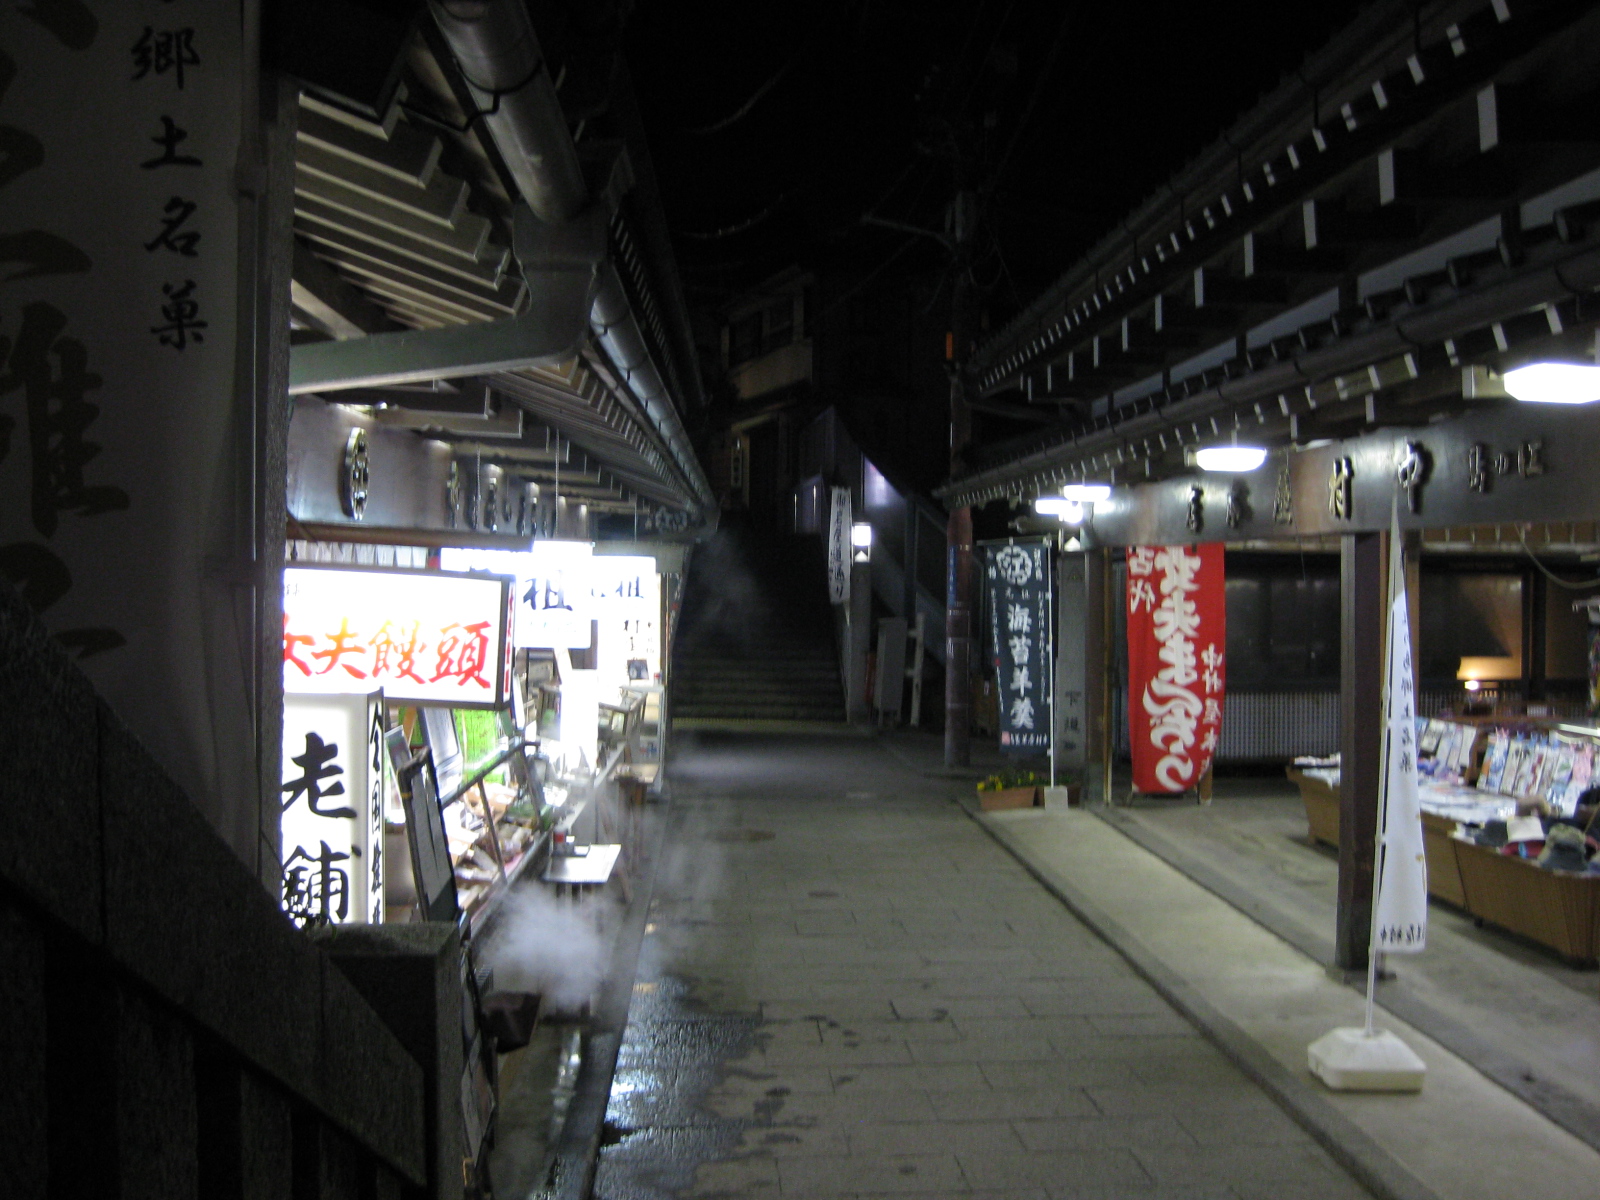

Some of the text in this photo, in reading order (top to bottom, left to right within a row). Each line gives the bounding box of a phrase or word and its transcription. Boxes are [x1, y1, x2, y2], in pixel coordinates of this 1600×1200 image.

[131, 26, 208, 350] 郷土名菓
[1007, 603, 1035, 730] 海苔羊羹
